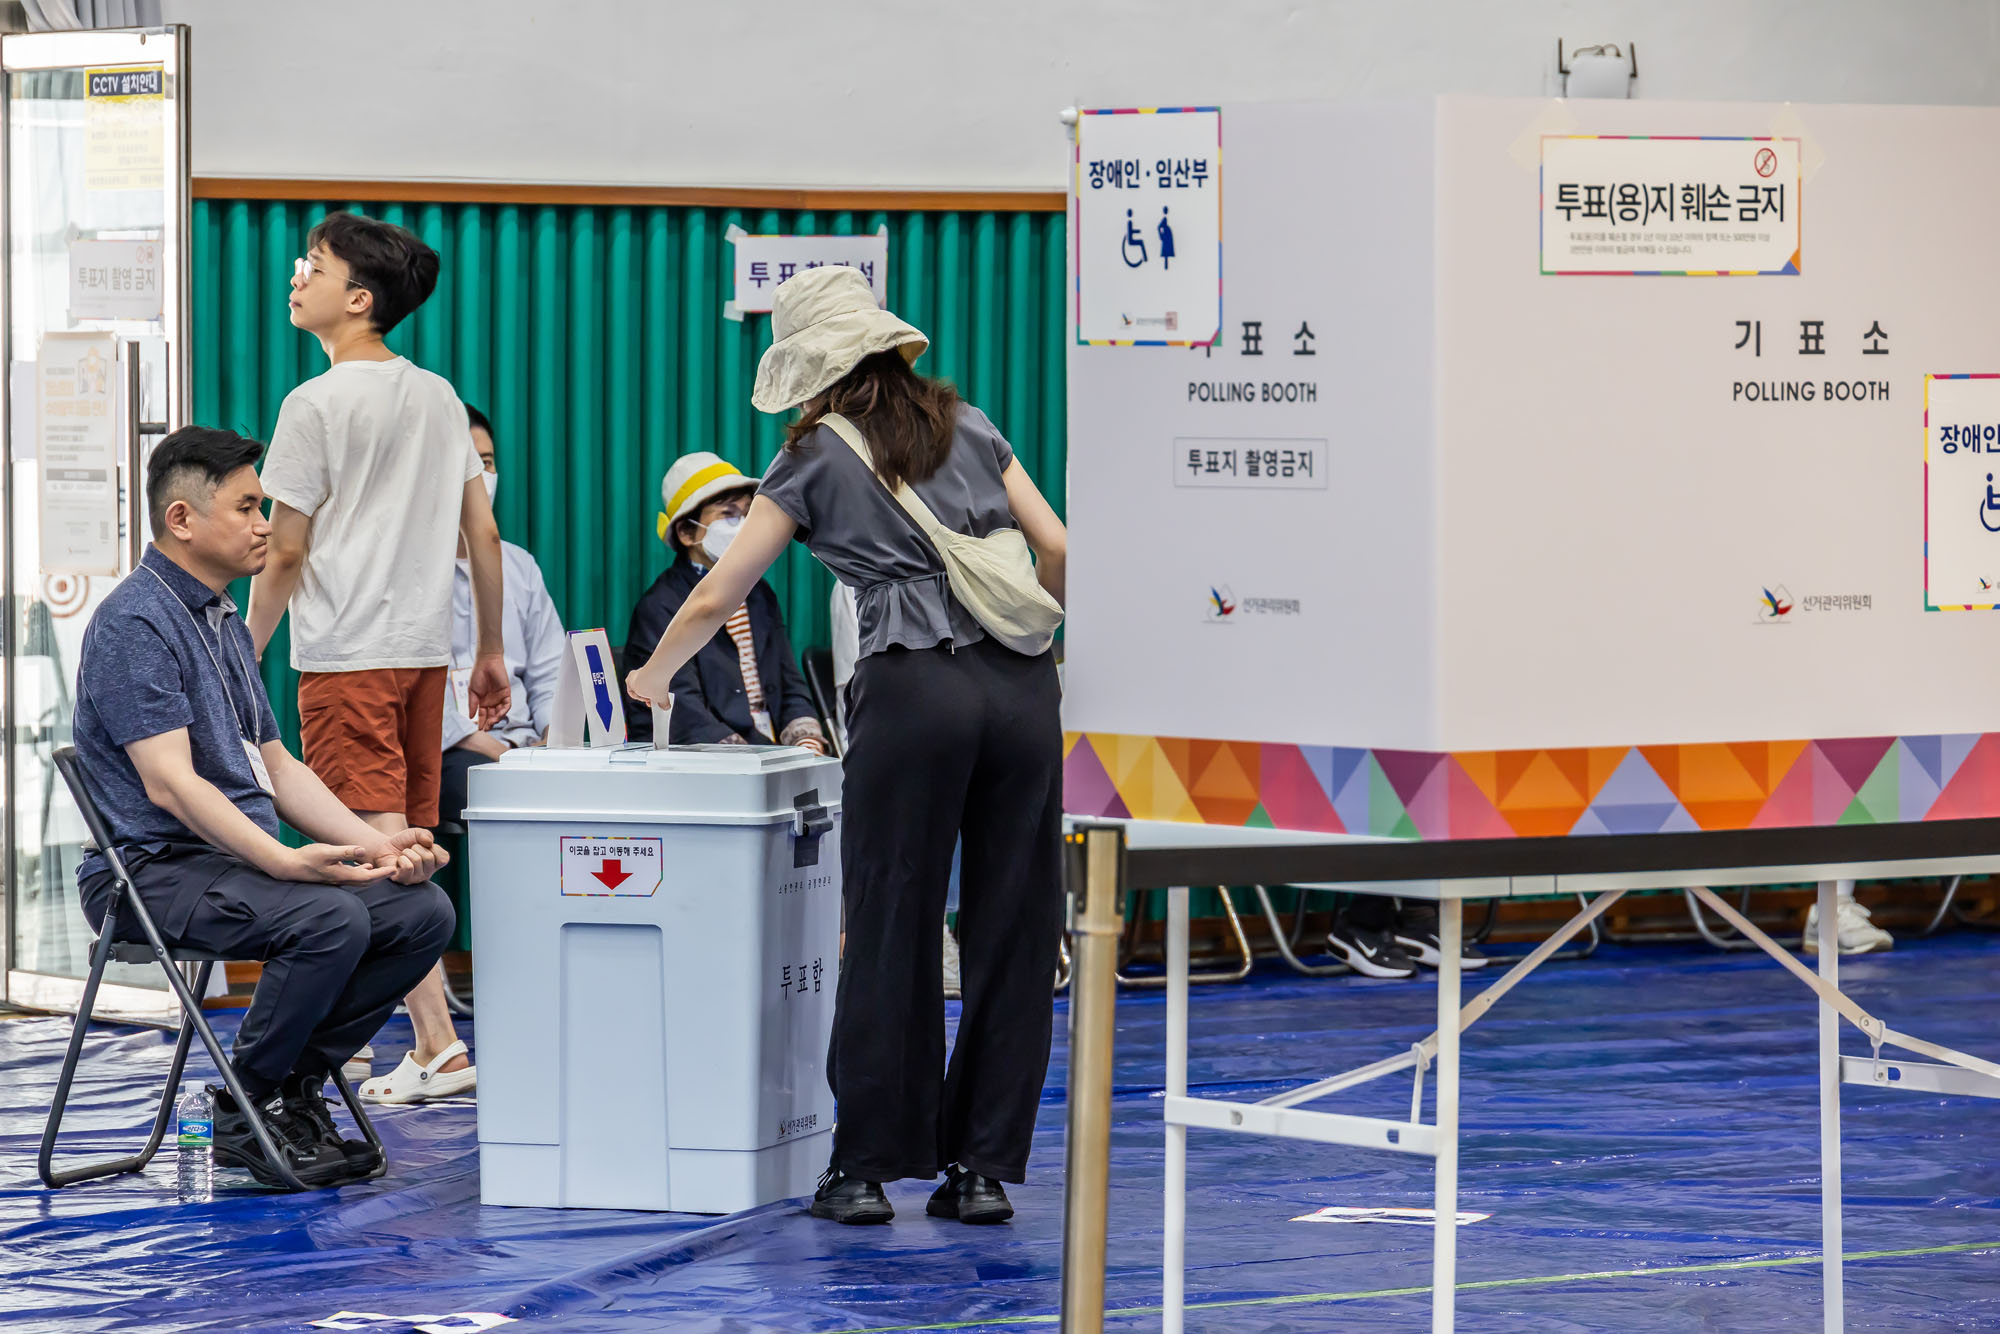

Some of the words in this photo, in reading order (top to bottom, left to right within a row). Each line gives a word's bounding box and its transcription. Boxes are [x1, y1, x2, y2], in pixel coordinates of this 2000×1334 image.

[92, 76, 119, 94] CCTV
[121, 71, 158, 94] 설치안내
[1555, 183, 1674, 226] 투표(용)지
[1681, 183, 1731, 222] 훼손
[1736, 183, 1784, 222] 금지
[78, 266, 108, 291] 투표지
[111, 266, 132, 291] 촬영
[135, 266, 155, 291] 금지
[1188, 382, 1256, 403] POLLING
[1261, 382, 1317, 403] BOOTH
[1733, 381, 1816, 401] POLLING
[1824, 381, 1889, 401] BOOTH
[1940, 424, 2000, 454] 장애인
[1187, 449, 1237, 477] 투표지
[1245, 449, 1313, 478] 촬영금지
[1802, 595, 1872, 611] 선거관리위원회
[592, 671, 605, 685] 투입구
[569, 845, 590, 856] 이곳을
[593, 846, 607, 856] 잡고
[609, 846, 631, 857] 이동해
[633, 846, 655, 857] 주세요
[781, 957, 824, 1001] 투표함
